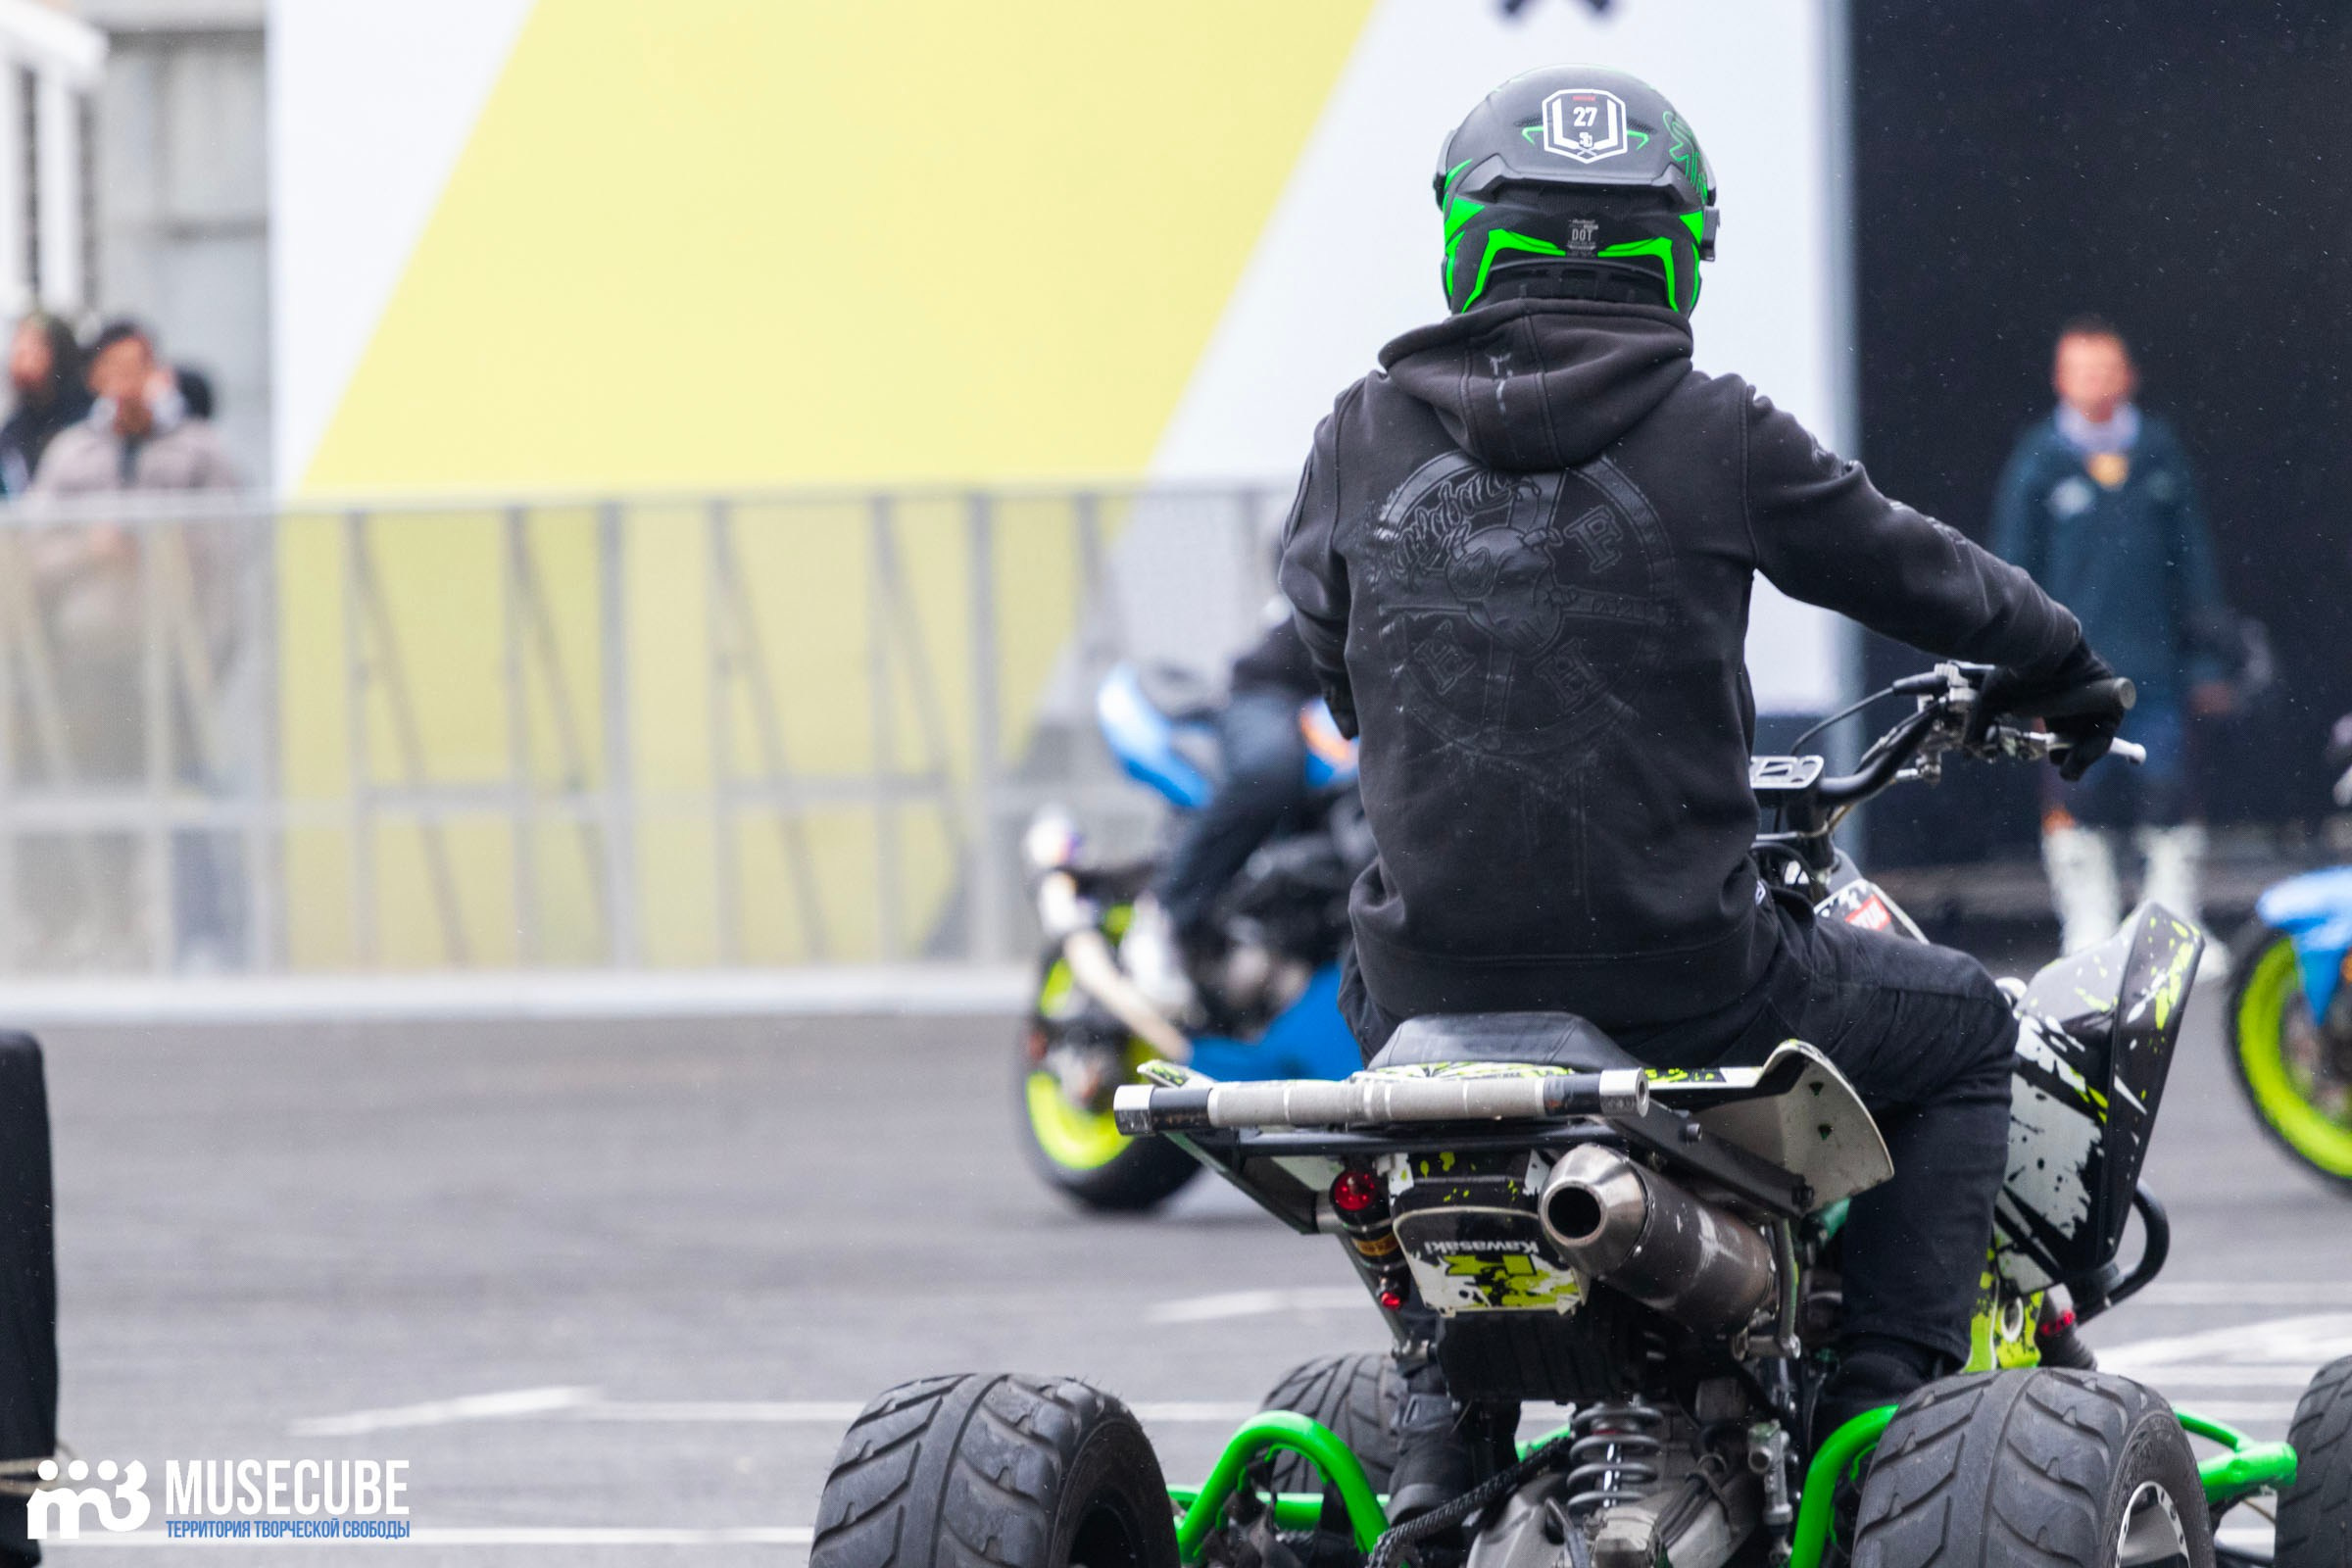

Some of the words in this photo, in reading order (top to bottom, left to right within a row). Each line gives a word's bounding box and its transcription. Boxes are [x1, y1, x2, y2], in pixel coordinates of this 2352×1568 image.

[1573, 106, 1597, 126] 27
[1571, 227, 1593, 242] DOT
[1424, 1240, 1540, 1255] Kawasaki
